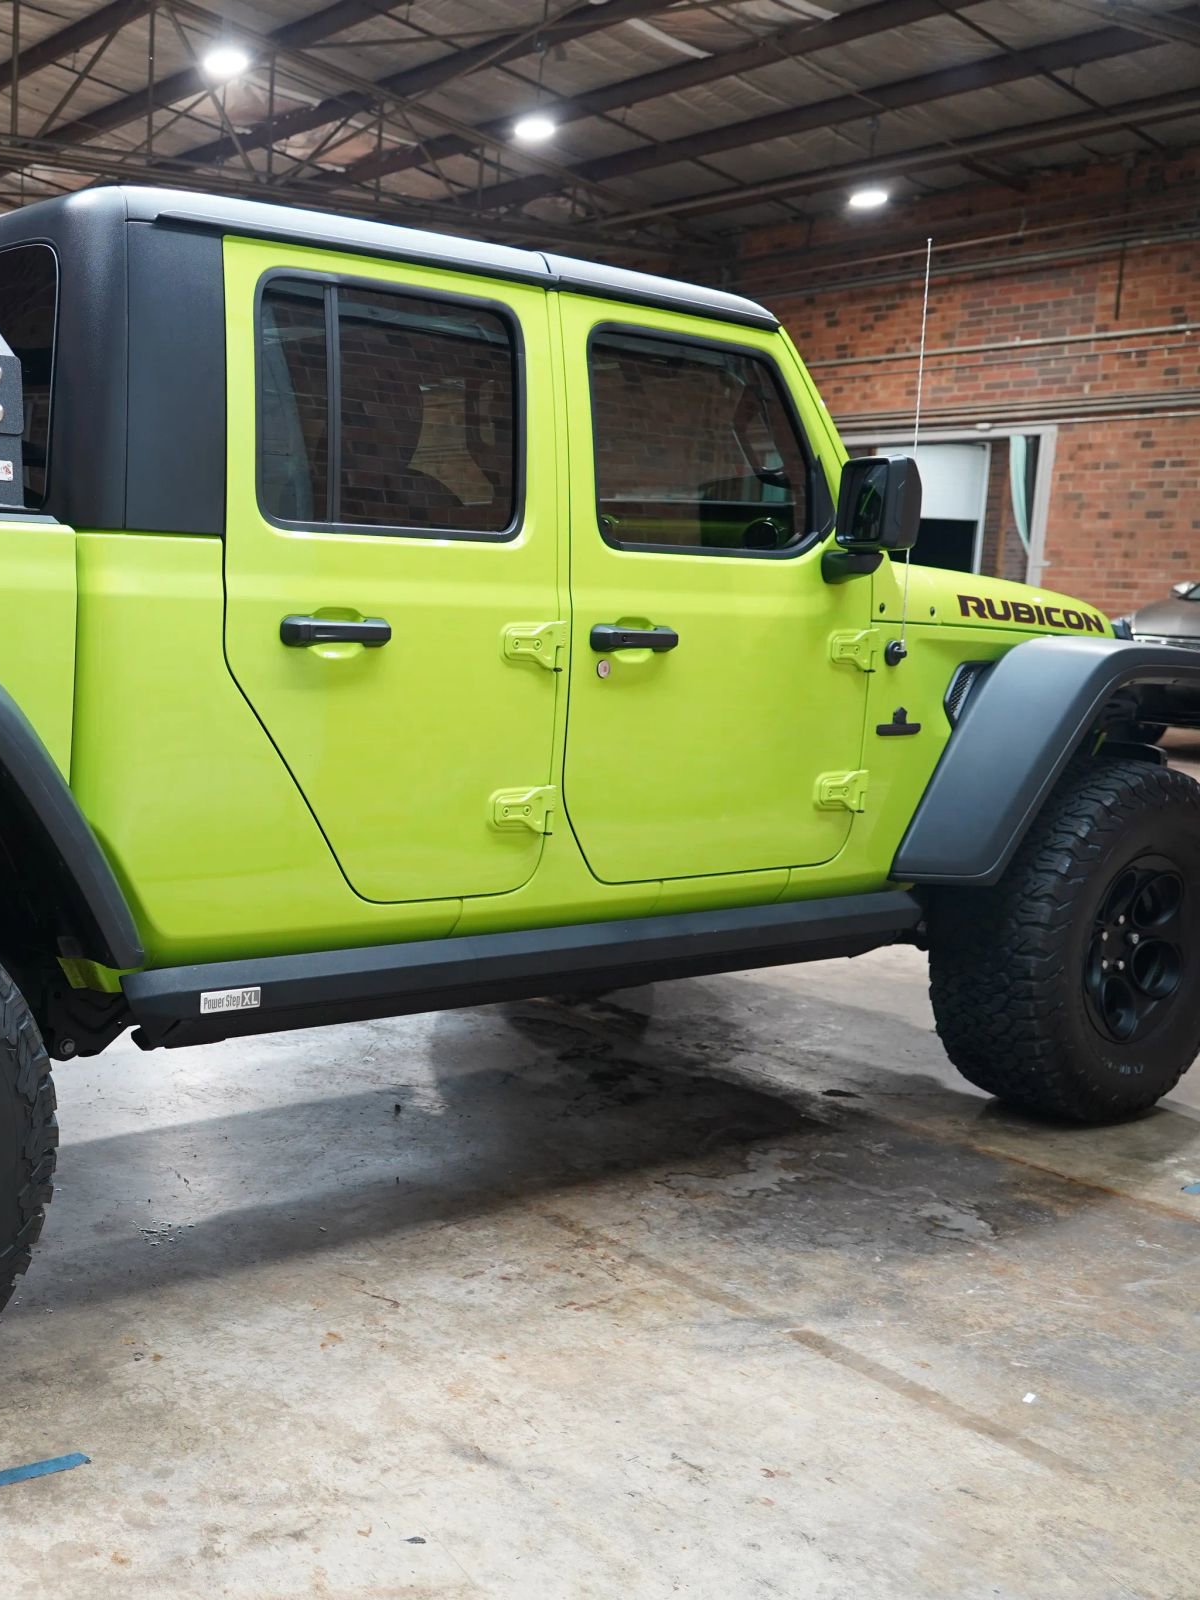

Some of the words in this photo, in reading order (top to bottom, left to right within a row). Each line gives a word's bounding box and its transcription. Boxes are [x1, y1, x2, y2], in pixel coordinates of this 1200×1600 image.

[957, 594, 1105, 634] RUBICON
[203, 997, 225, 1010] Power
[225, 995, 240, 1008] Step
[243, 992, 259, 1005] XL
